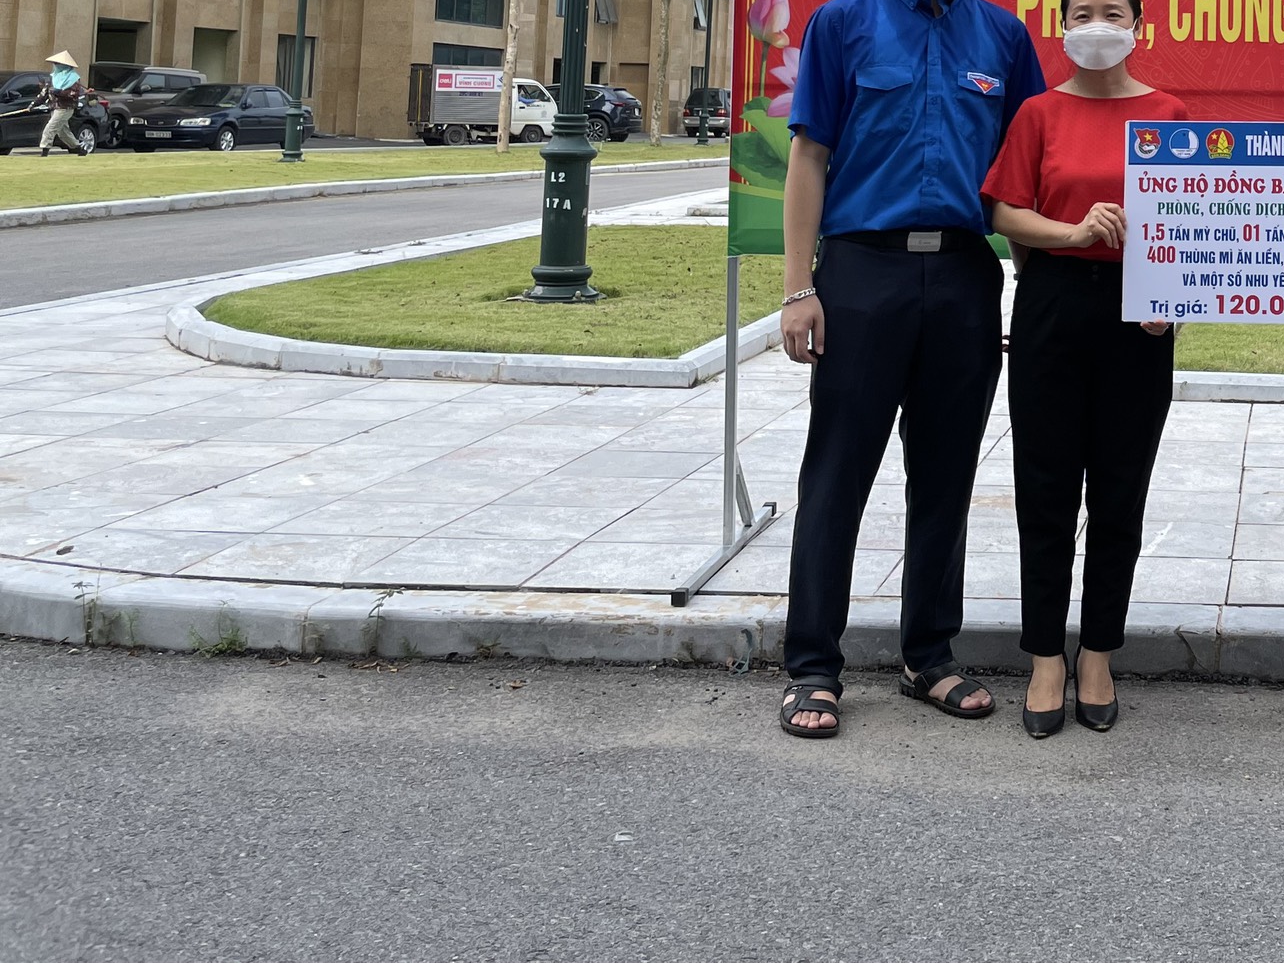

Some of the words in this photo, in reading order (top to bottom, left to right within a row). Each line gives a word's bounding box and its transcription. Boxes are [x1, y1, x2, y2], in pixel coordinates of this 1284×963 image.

[551, 172, 565, 182] L2
[1138, 171, 1177, 193] ỦNG
[1183, 173, 1208, 197] HỘ
[1214, 170, 1266, 193] ĐỒNG
[1158, 200, 1204, 216] PHÒNG,
[1209, 198, 1250, 215] CHỐNG
[1142, 223, 1165, 243] 1,5
[1168, 224, 1190, 241] TẤN
[1194, 226, 1210, 241] MỲ
[1214, 226, 1239, 243] CHŨ,
[1243, 224, 1259, 241] 01
[1147, 246, 1175, 263] 400
[1179, 249, 1215, 264] THÙNG
[1219, 248, 1233, 264] MÌ
[1237, 249, 1252, 264] ĂN
[1256, 248, 1283, 266] LIỀN,
[1183, 273, 1196, 286] VÀ
[1200, 271, 1224, 289] MỘT
[1227, 270, 1242, 287] SỐ
[1246, 274, 1268, 287] NHU
[1150, 300, 1168, 317] Trị
[1175, 299, 1207, 317] giá:
